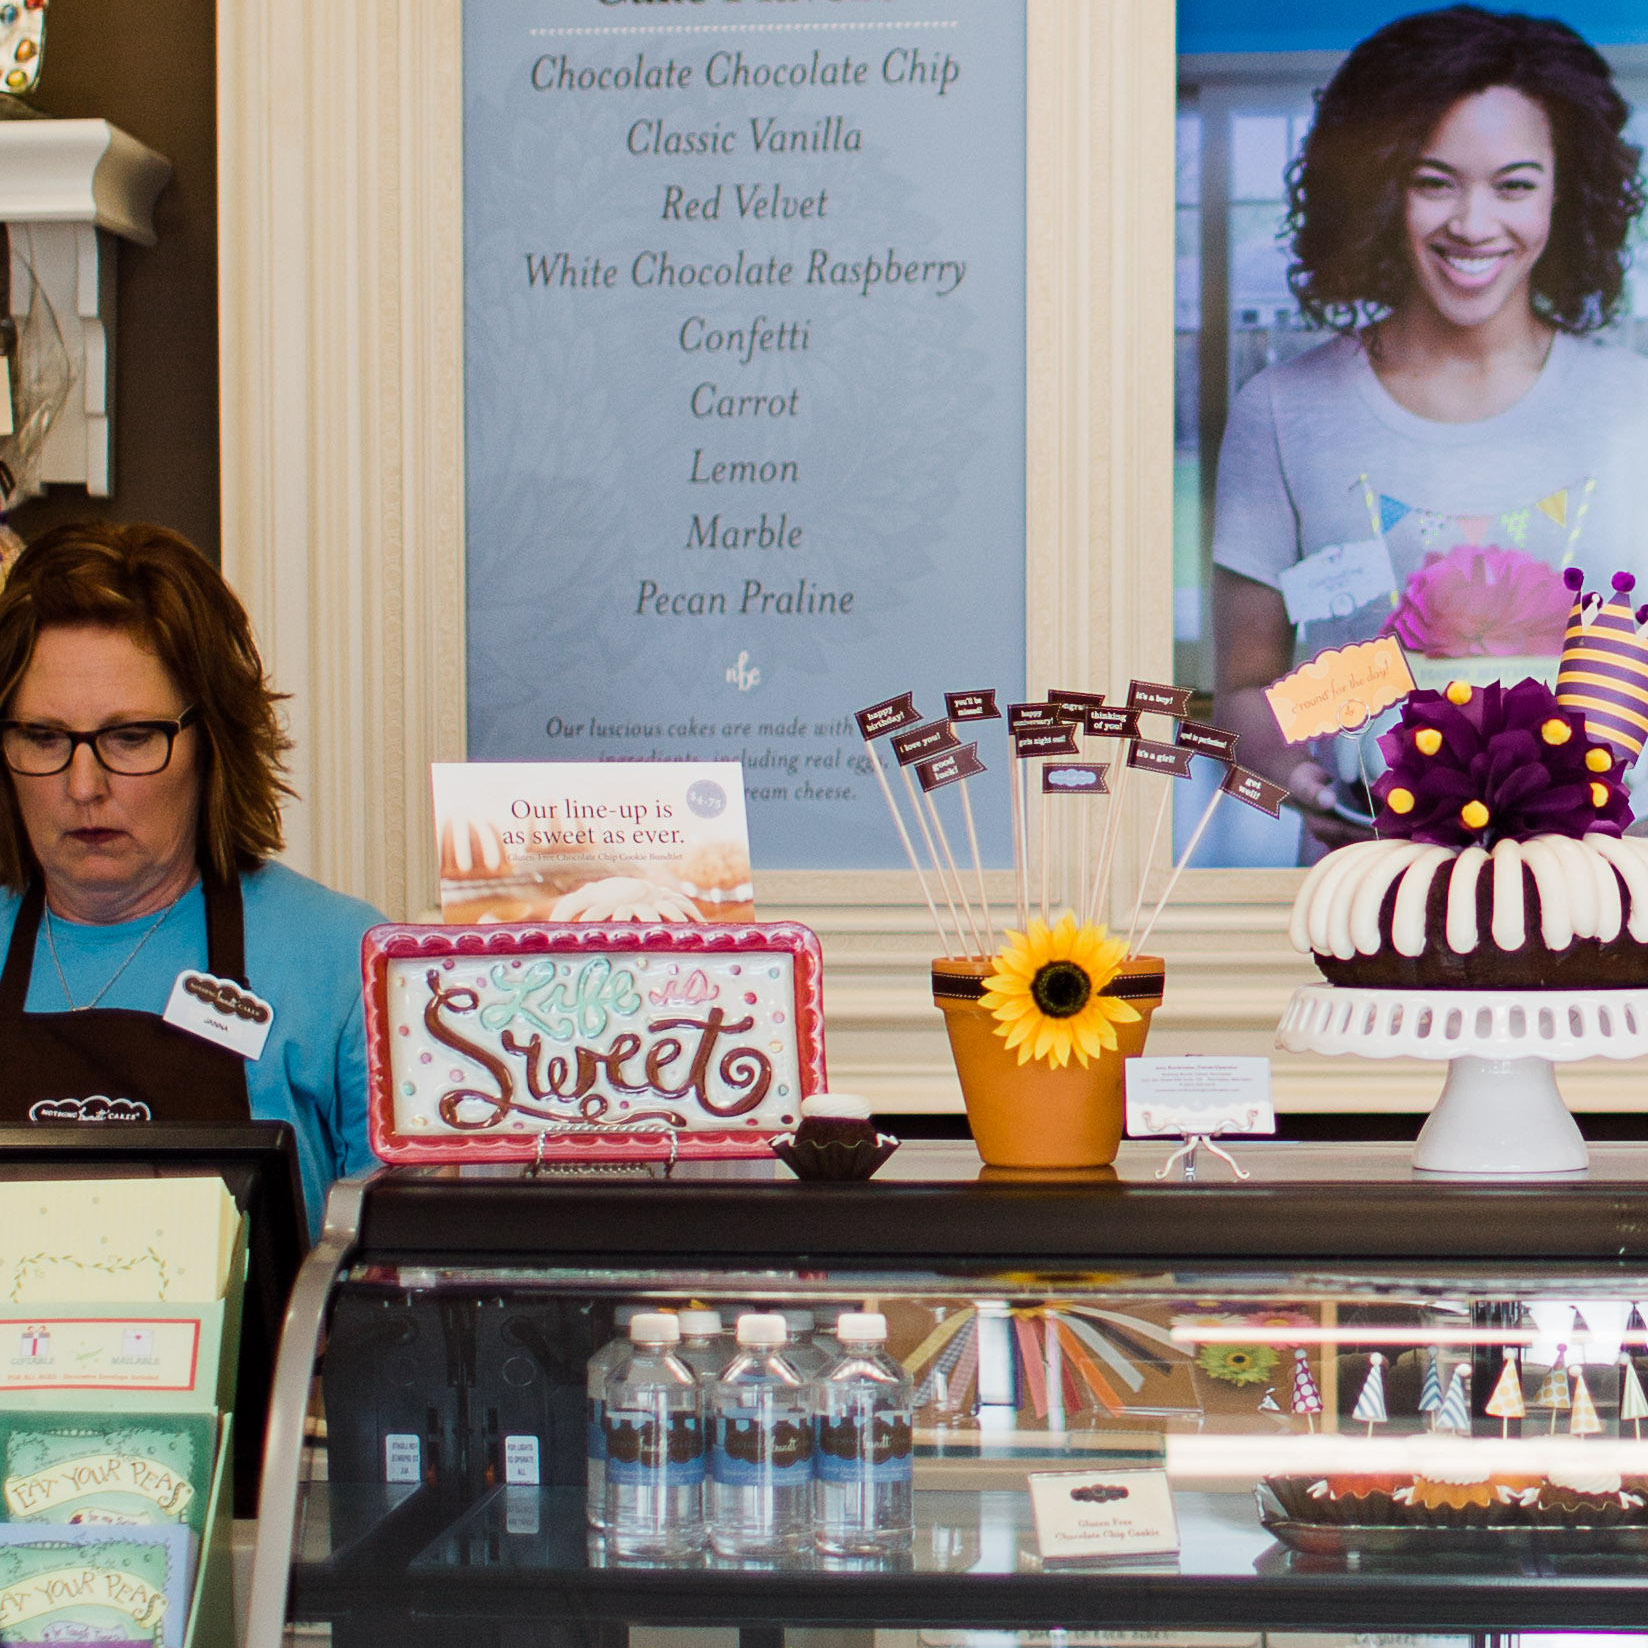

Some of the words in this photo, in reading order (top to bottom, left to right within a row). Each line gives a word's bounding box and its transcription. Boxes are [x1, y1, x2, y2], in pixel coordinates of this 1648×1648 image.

[529, 52, 692, 95] Chocolate
[705, 51, 868, 91] Chocolate
[881, 47, 960, 95] Chip
[626, 119, 736, 156] Classic
[747, 117, 862, 155] Vanilla
[661, 185, 722, 221] Red
[732, 184, 827, 221] Velvet
[524, 252, 616, 290] White
[631, 251, 793, 288] Chocolate
[805, 250, 966, 296] Raspberry
[678, 316, 810, 365] Confetti
[689, 384, 798, 420] Carrot
[688, 450, 798, 486] Lemon
[685, 514, 801, 551] Marble
[635, 582, 725, 618] Pecan
[738, 581, 853, 616] Praline
[1330, 679, 1346, 698] for
[1350, 673, 1364, 688] the
[1367, 659, 1389, 682] day!
[974, 697, 982, 705] be
[1156, 694, 1173, 705] boy!
[867, 706, 893, 721] happy
[867, 711, 905, 732] birthday!
[1091, 712, 1127, 722] thinking
[546, 717, 583, 737] Our
[590, 717, 662, 737] luscious
[668, 717, 714, 737] cakes
[722, 722, 750, 737] are
[759, 717, 807, 736] made
[814, 717, 853, 737] with
[1094, 722, 1103, 730] of
[1104, 722, 1122, 730] you!
[905, 739, 922, 752] love
[922, 732, 941, 747] you!
[805, 752, 840, 767] real
[932, 756, 955, 772] good
[1156, 754, 1175, 763] girl!
[935, 766, 959, 781] luck!
[1245, 778, 1261, 789] get
[795, 784, 856, 801] cheese.
[1239, 785, 1261, 800] well!
[511, 800, 557, 819] Our
[566, 798, 647, 824] line-up
[656, 799, 673, 819] is
[503, 830, 525, 844] as
[533, 827, 595, 844] sweet
[603, 830, 625, 844] as
[633, 829, 684, 844] ever.
[556, 853, 595, 861] Chocolate
[598, 853, 617, 862] Chip
[619, 853, 647, 861] Cookie
[480, 957, 643, 1041] Life
[649, 969, 720, 1006] is
[424, 968, 771, 1129] Sweet
[12, 1479, 58, 1509] EAT
[61, 1458, 121, 1492] YOUR
[130, 1461, 186, 1509] PEAS
[1055, 1531, 1101, 1541] Chocolate
[1103, 1531, 1125, 1539] Chip
[34, 1571, 95, 1604] YOUR
[105, 1574, 161, 1621] PEAS
